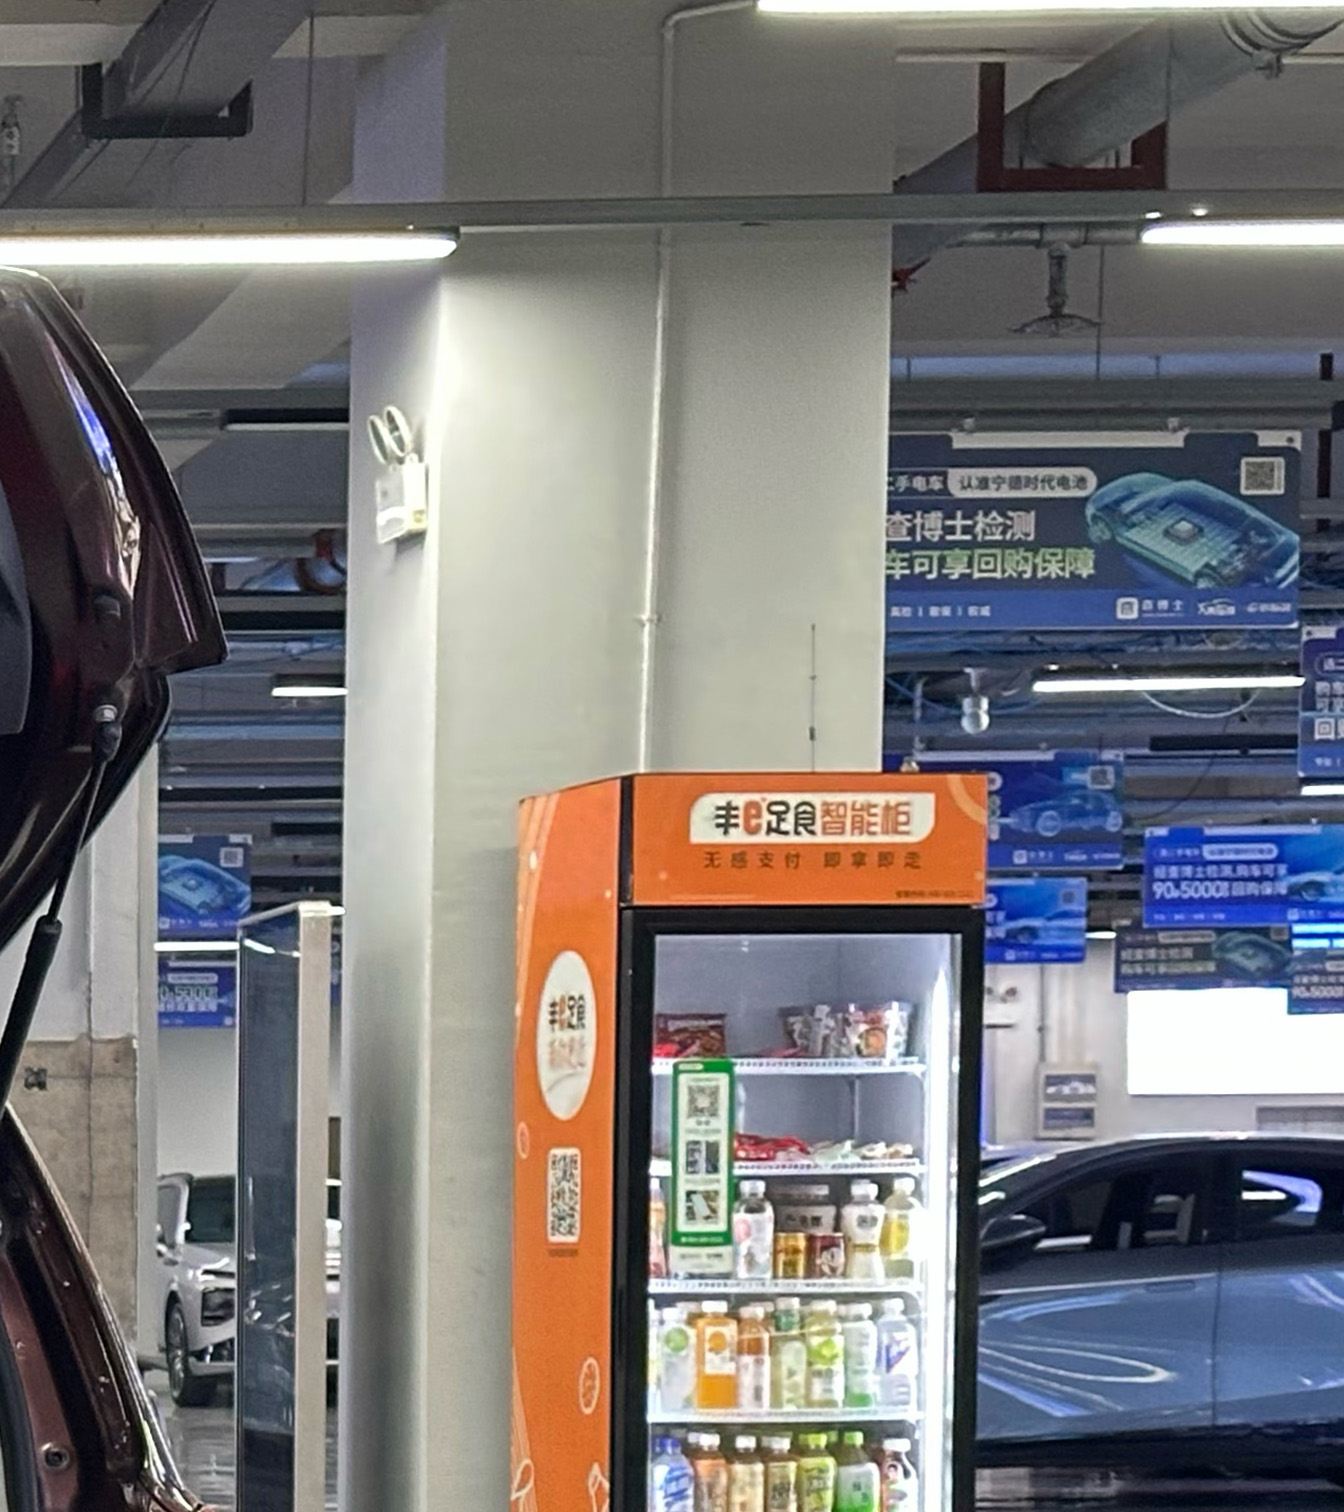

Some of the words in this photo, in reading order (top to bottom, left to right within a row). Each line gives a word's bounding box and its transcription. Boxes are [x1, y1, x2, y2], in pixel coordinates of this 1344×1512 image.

[886, 510, 1036, 543] 查博士检测
[885, 547, 1096, 581] 车可享回购保障
[714, 799, 912, 837] 丰e足食智能柜
[703, 851, 802, 870] 无感支付
[823, 851, 922, 870] 即拿即走
